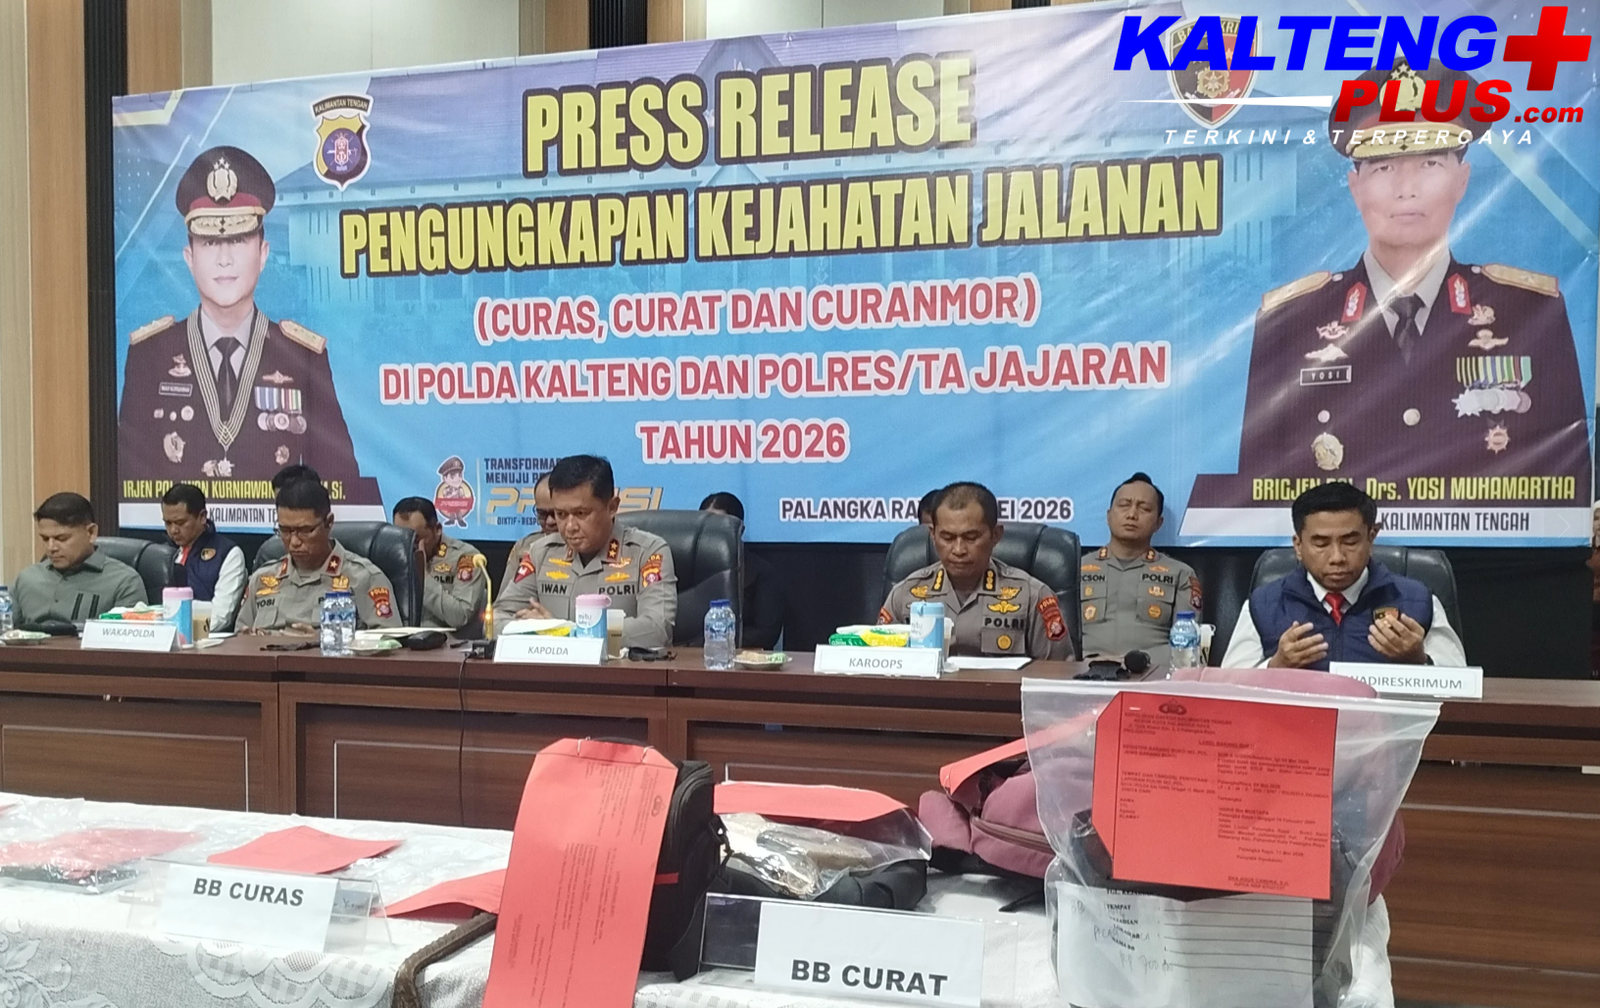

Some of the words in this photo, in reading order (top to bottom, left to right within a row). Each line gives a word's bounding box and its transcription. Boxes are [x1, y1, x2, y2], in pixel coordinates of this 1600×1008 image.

[315, 99, 347, 114] KALIMANTAN
[347, 98, 369, 110] TENGAH
[525, 77, 705, 175] PRESS
[718, 56, 973, 161] RELEASE
[341, 190, 687, 276] PENGUNGKAPAN
[696, 172, 972, 259] KEJAHATAN
[979, 157, 1221, 243] JALANAN
[476, 298, 607, 341] (CURAS,
[612, 294, 723, 334] CURAT
[731, 290, 802, 330] DAN
[812, 277, 1037, 326] CURANMOR)
[382, 367, 410, 401] DI
[417, 366, 518, 400] POLDA
[525, 361, 672, 398] KALTENG
[680, 359, 750, 396] DAN
[759, 352, 966, 394] POLRES/TA
[974, 345, 1167, 388] JAJARAN
[640, 424, 752, 460] TAHUN
[761, 422, 847, 460] 2026
[484, 457, 562, 472] TRANSFORMA
[485, 472, 529, 484] MENUJU
[123, 480, 153, 499] IRJEN
[1366, 477, 1401, 501] Drs.
[1407, 477, 1445, 500] YOSI
[1449, 476, 1576, 501] MUHAMARTHA
[209, 507, 265, 524] KALIMANTAN
[781, 499, 888, 520] PALANGKA
[1020, 498, 1074, 520] 2026
[1381, 513, 1472, 533] KALIMANTAN
[1475, 512, 1531, 532] TENGAH
[434, 575, 454, 584] OLRI
[1142, 573, 1174, 585] POLRI
[541, 583, 568, 597] IWAN
[599, 584, 636, 598] POLRI
[984, 617, 1024, 630] POLRI
[102, 627, 156, 640] WAKAPOLDA
[527, 645, 569, 656] KAPOLDA
[848, 656, 903, 670] KAROOPS
[192, 878, 222, 898] BB
[229, 881, 304, 907] CURAS
[791, 959, 831, 983] BB
[841, 965, 948, 997] CURAT
